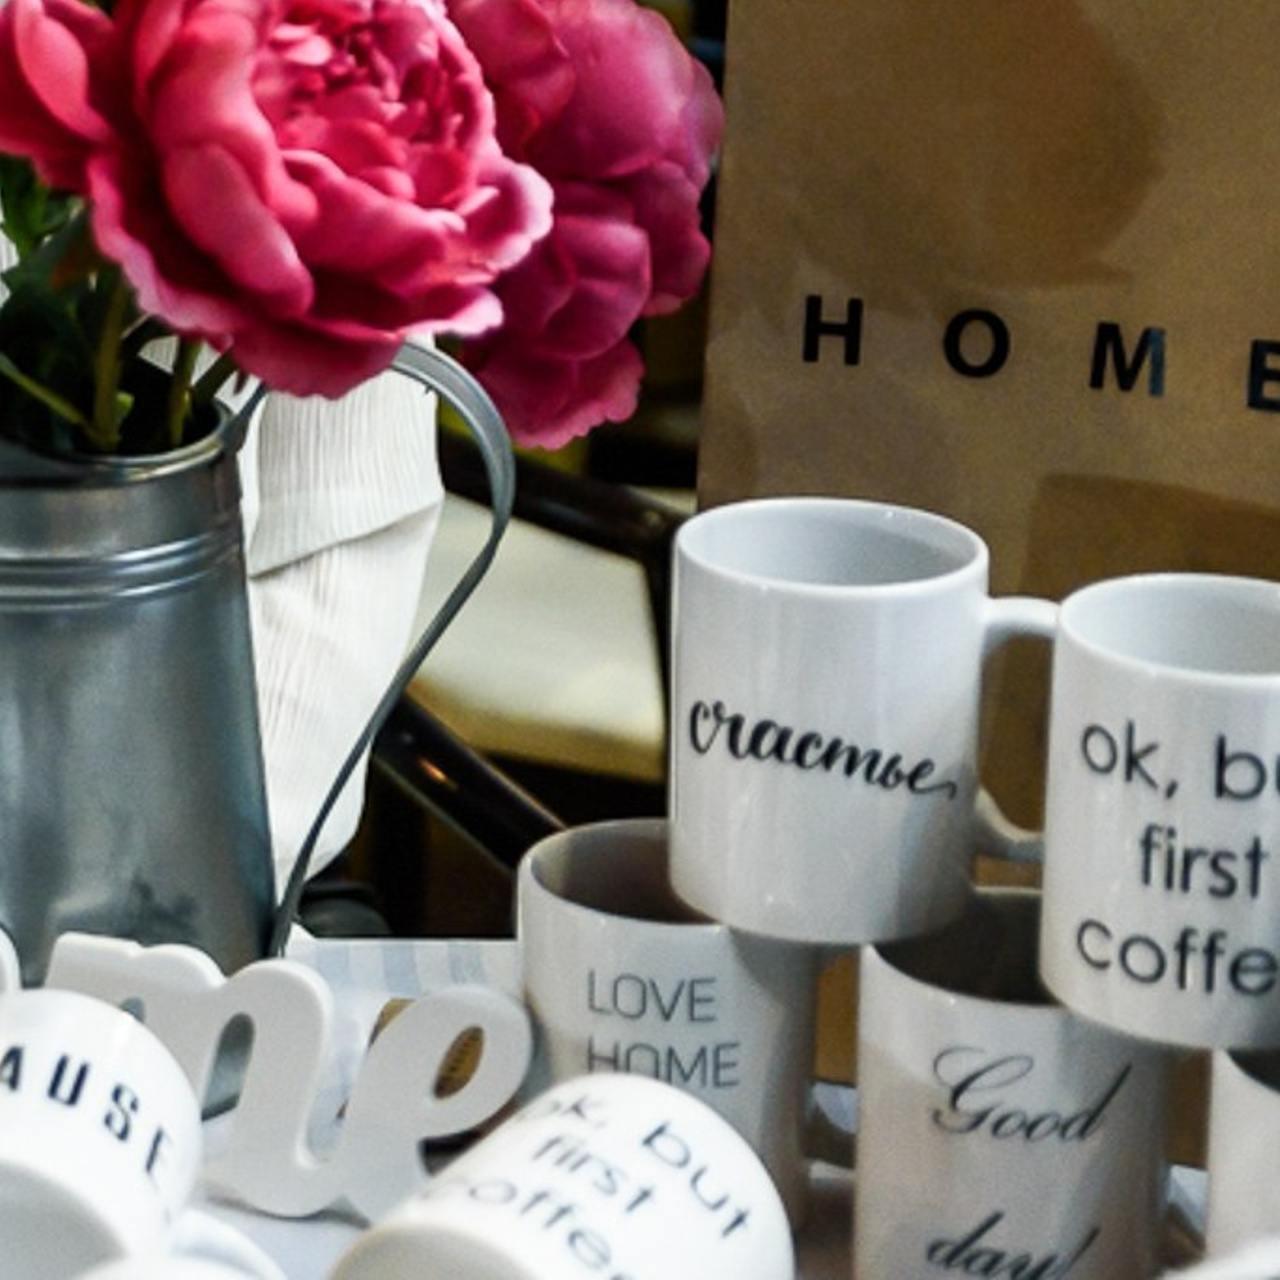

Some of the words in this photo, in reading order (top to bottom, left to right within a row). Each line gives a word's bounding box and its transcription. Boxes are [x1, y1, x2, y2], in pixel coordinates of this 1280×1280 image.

[1080, 721, 1179, 799] ok,
[1215, 733, 1280, 801] b
[1140, 823, 1269, 899] first
[586, 969, 718, 1023] LOVE
[932, 1046, 1133, 1142] Good
[531, 1132, 654, 1214] first
[641, 1120, 750, 1238] but
